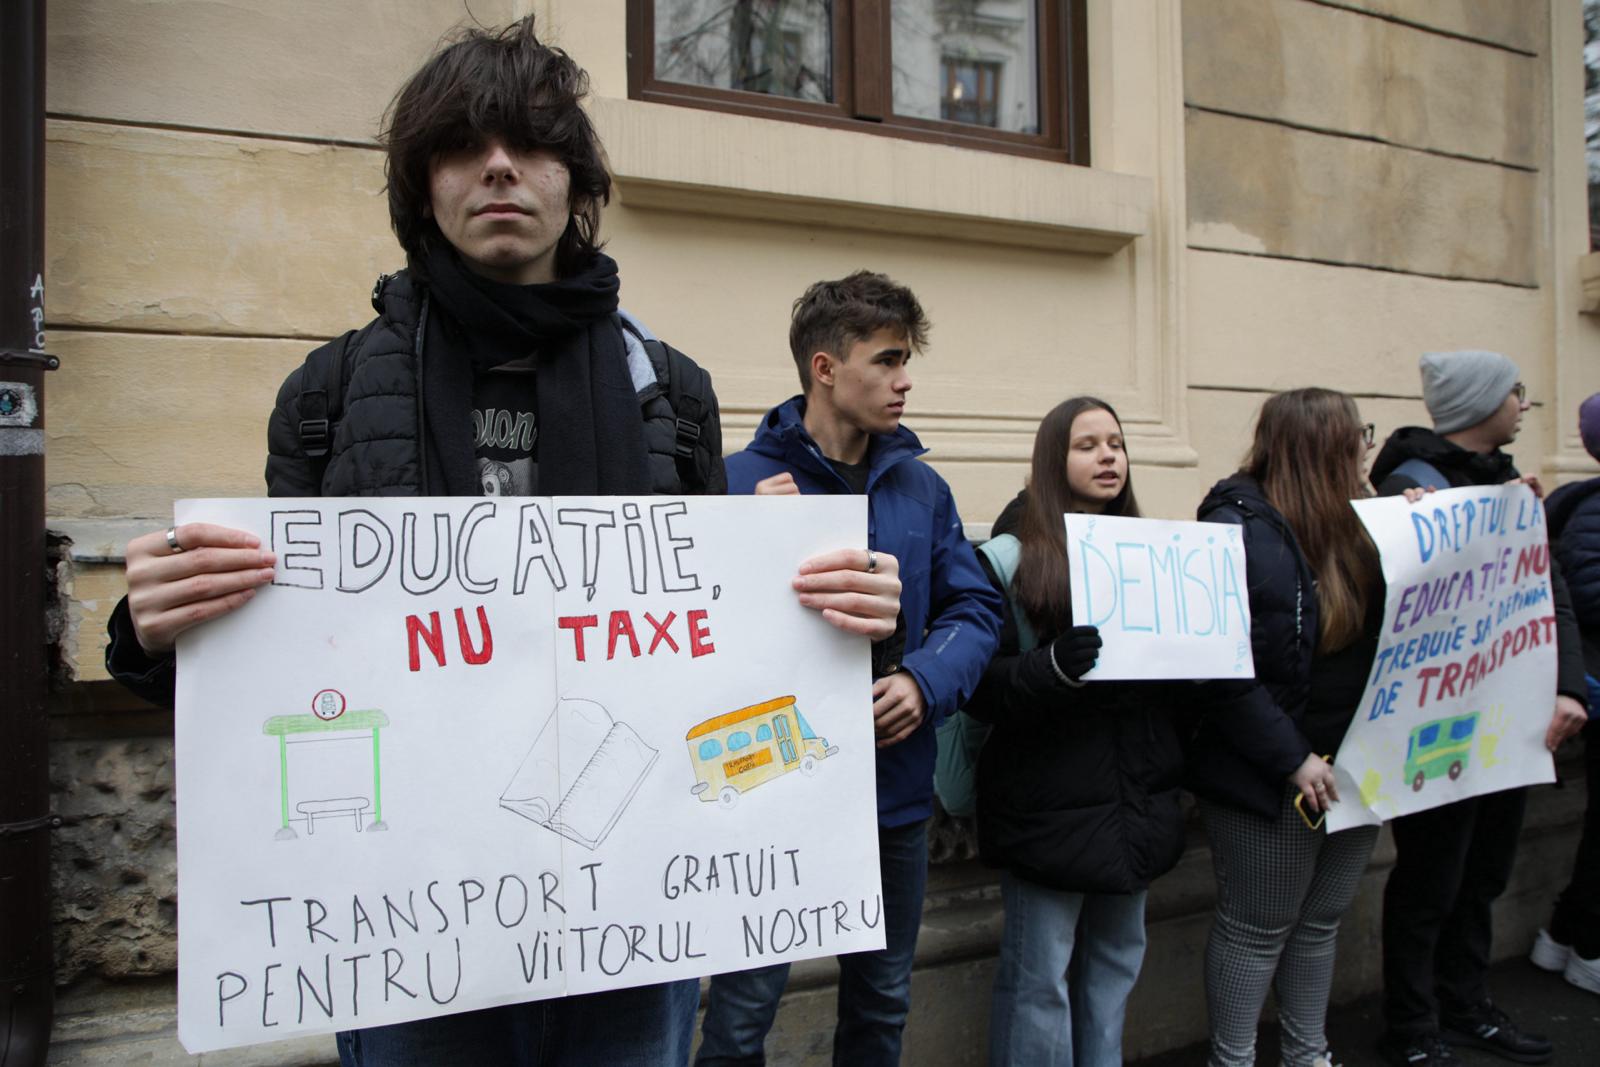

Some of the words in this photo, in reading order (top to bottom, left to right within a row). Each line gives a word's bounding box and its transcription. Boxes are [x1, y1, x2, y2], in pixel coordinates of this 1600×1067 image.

[1411, 497, 1508, 563] DREPTUL
[1516, 495, 1541, 531] LA
[1513, 543, 1549, 585] NU
[405, 605, 494, 672] NU
[558, 609, 716, 662] TAXE
[1368, 680, 1403, 721] DE
[1416, 615, 1556, 708] TRANSPORT
[240, 863, 603, 948] TRANSPORT
[216, 937, 462, 1027] PENTRU
[742, 893, 881, 958] NOSTRU
